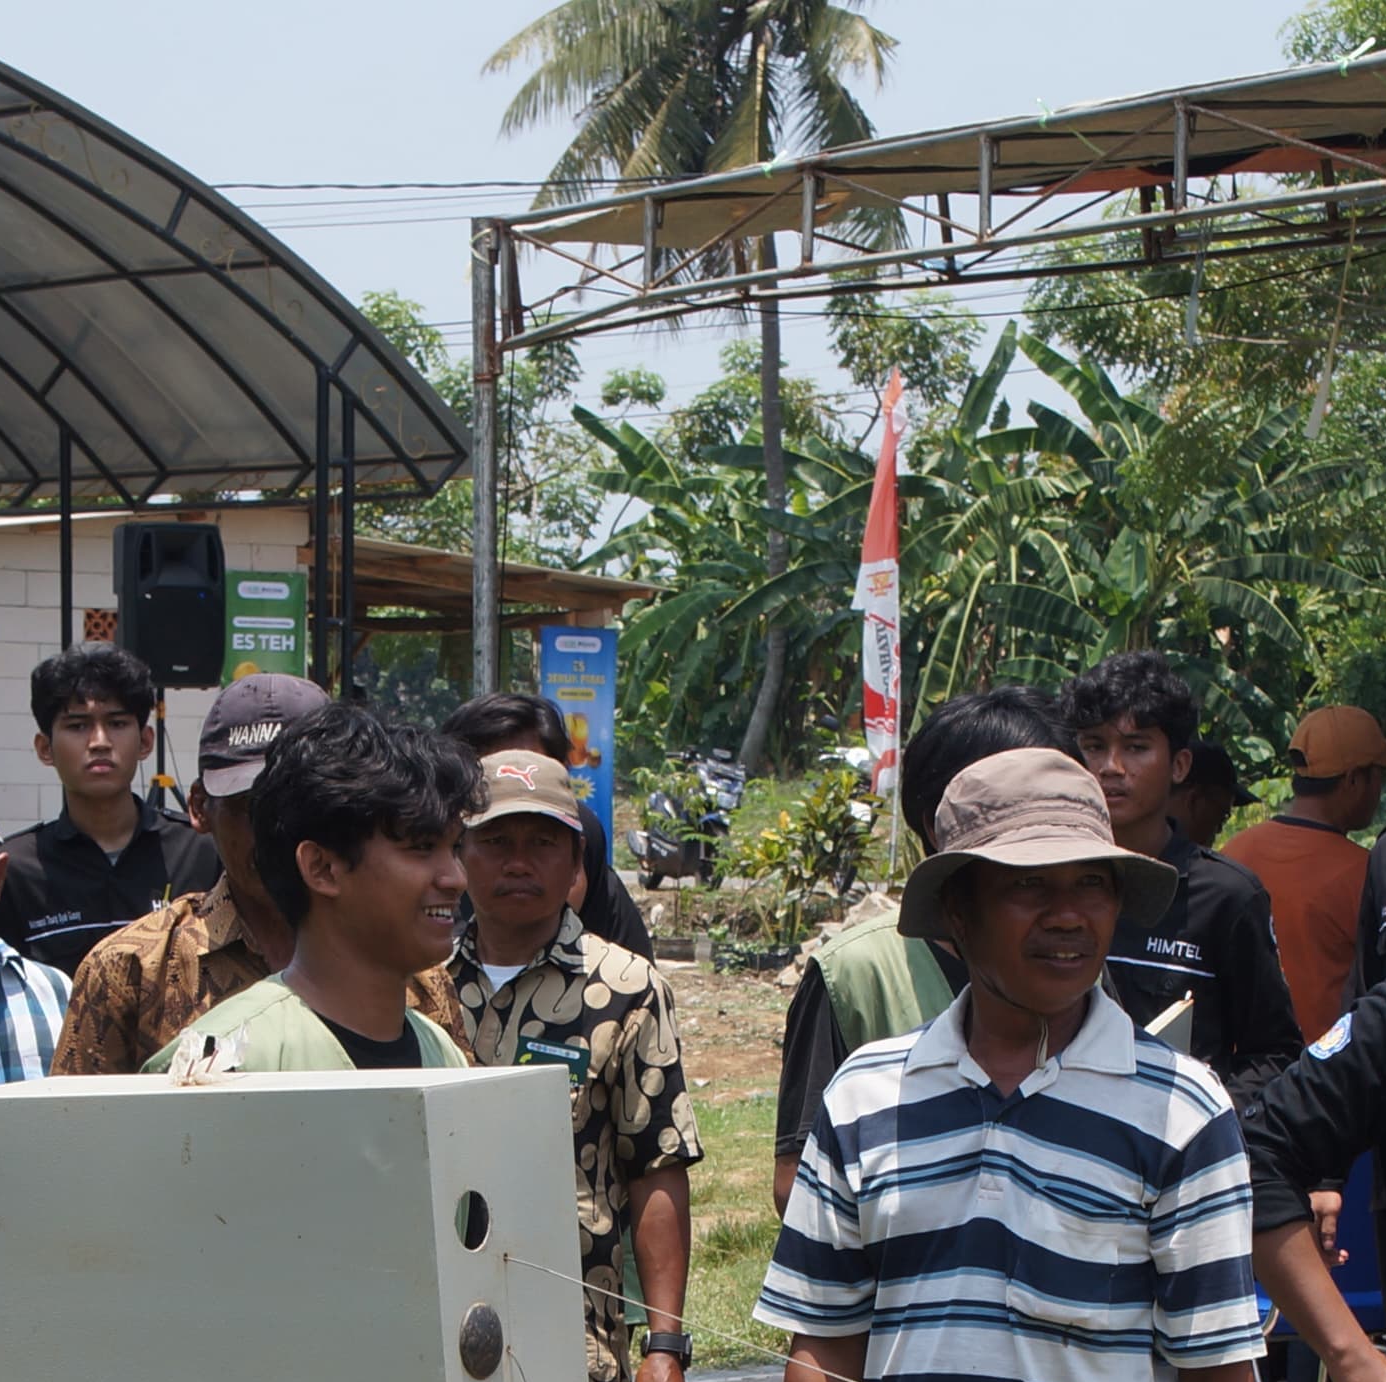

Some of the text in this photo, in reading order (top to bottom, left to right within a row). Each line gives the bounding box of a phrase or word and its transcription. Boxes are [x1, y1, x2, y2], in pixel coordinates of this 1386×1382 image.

[232, 633, 295, 651] ES TEH
[1146, 936, 1202, 960] HIMTEL
